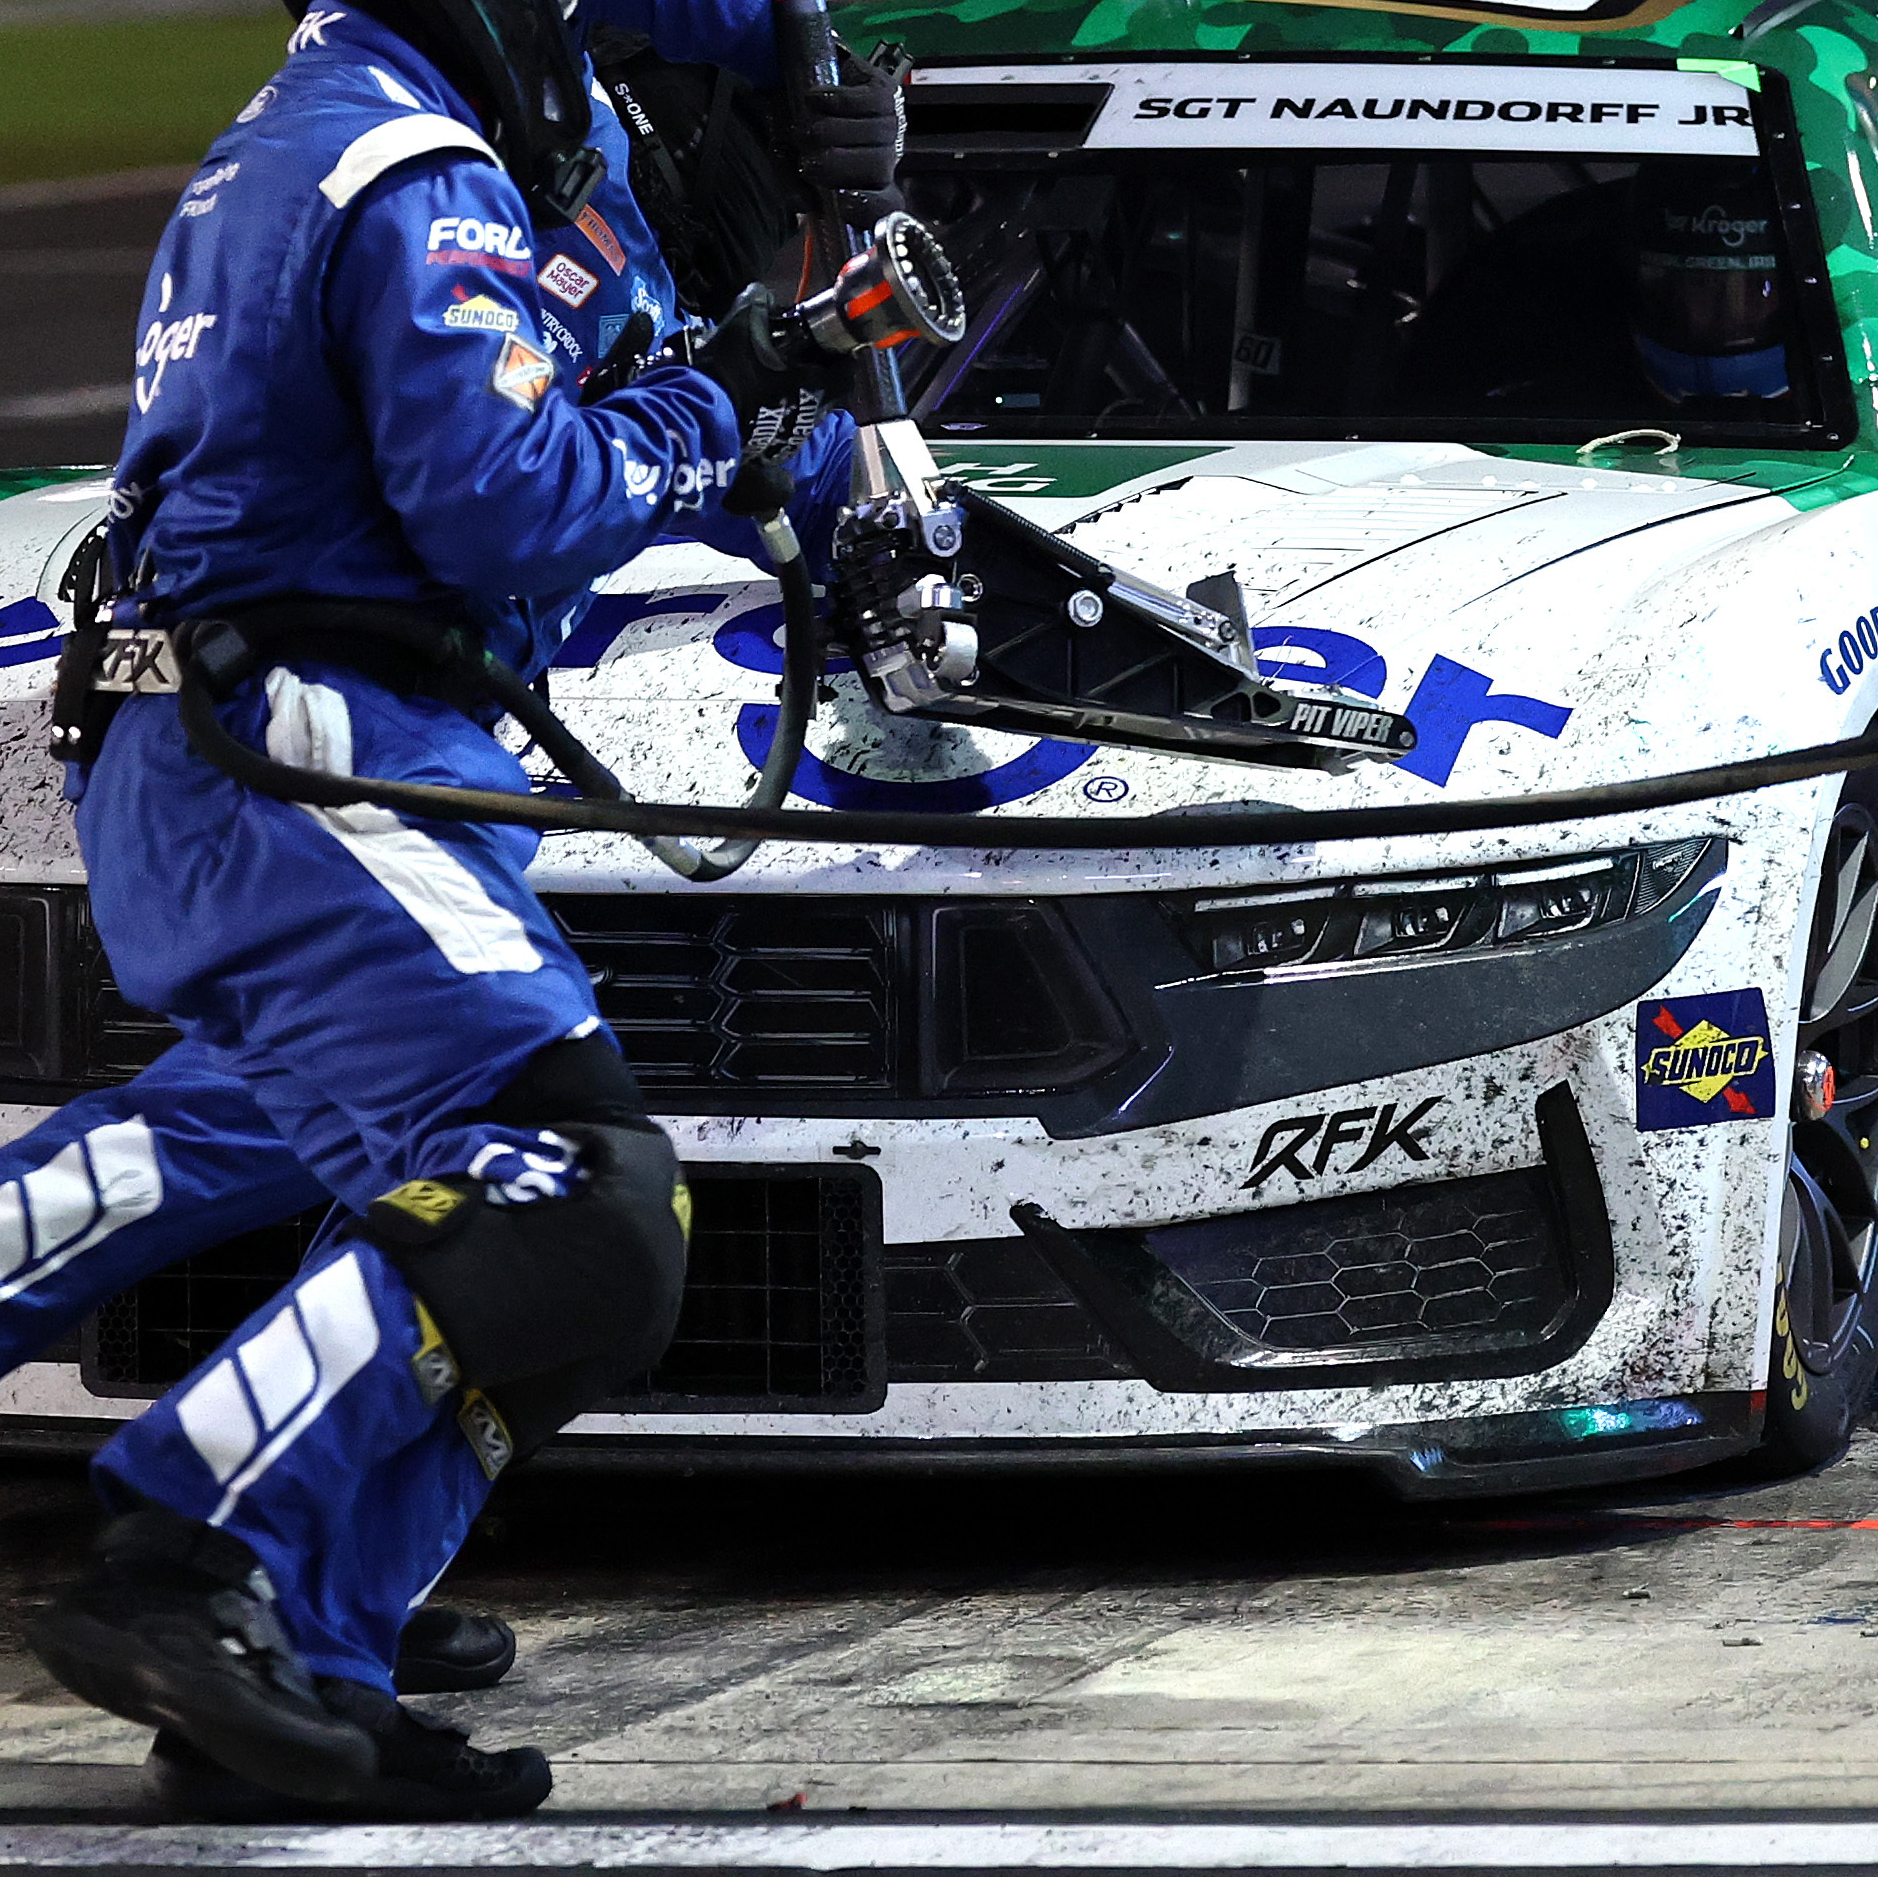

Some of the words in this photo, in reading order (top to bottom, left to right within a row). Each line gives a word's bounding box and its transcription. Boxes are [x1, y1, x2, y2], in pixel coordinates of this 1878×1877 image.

[1133, 96, 1257, 121] SGT
[1269, 97, 1661, 125] NAUNDORFF
[1676, 103, 1755, 127] JR
[547, 270, 584, 300] Mayer
[555, 261, 590, 289] Oscar
[449, 308, 515, 329] SUNOCO
[1289, 702, 1332, 734] PIT
[1331, 707, 1395, 743] VIPER
[1648, 1040, 1762, 1086] SUNOCO
[1239, 1094, 1447, 1191] RFK
